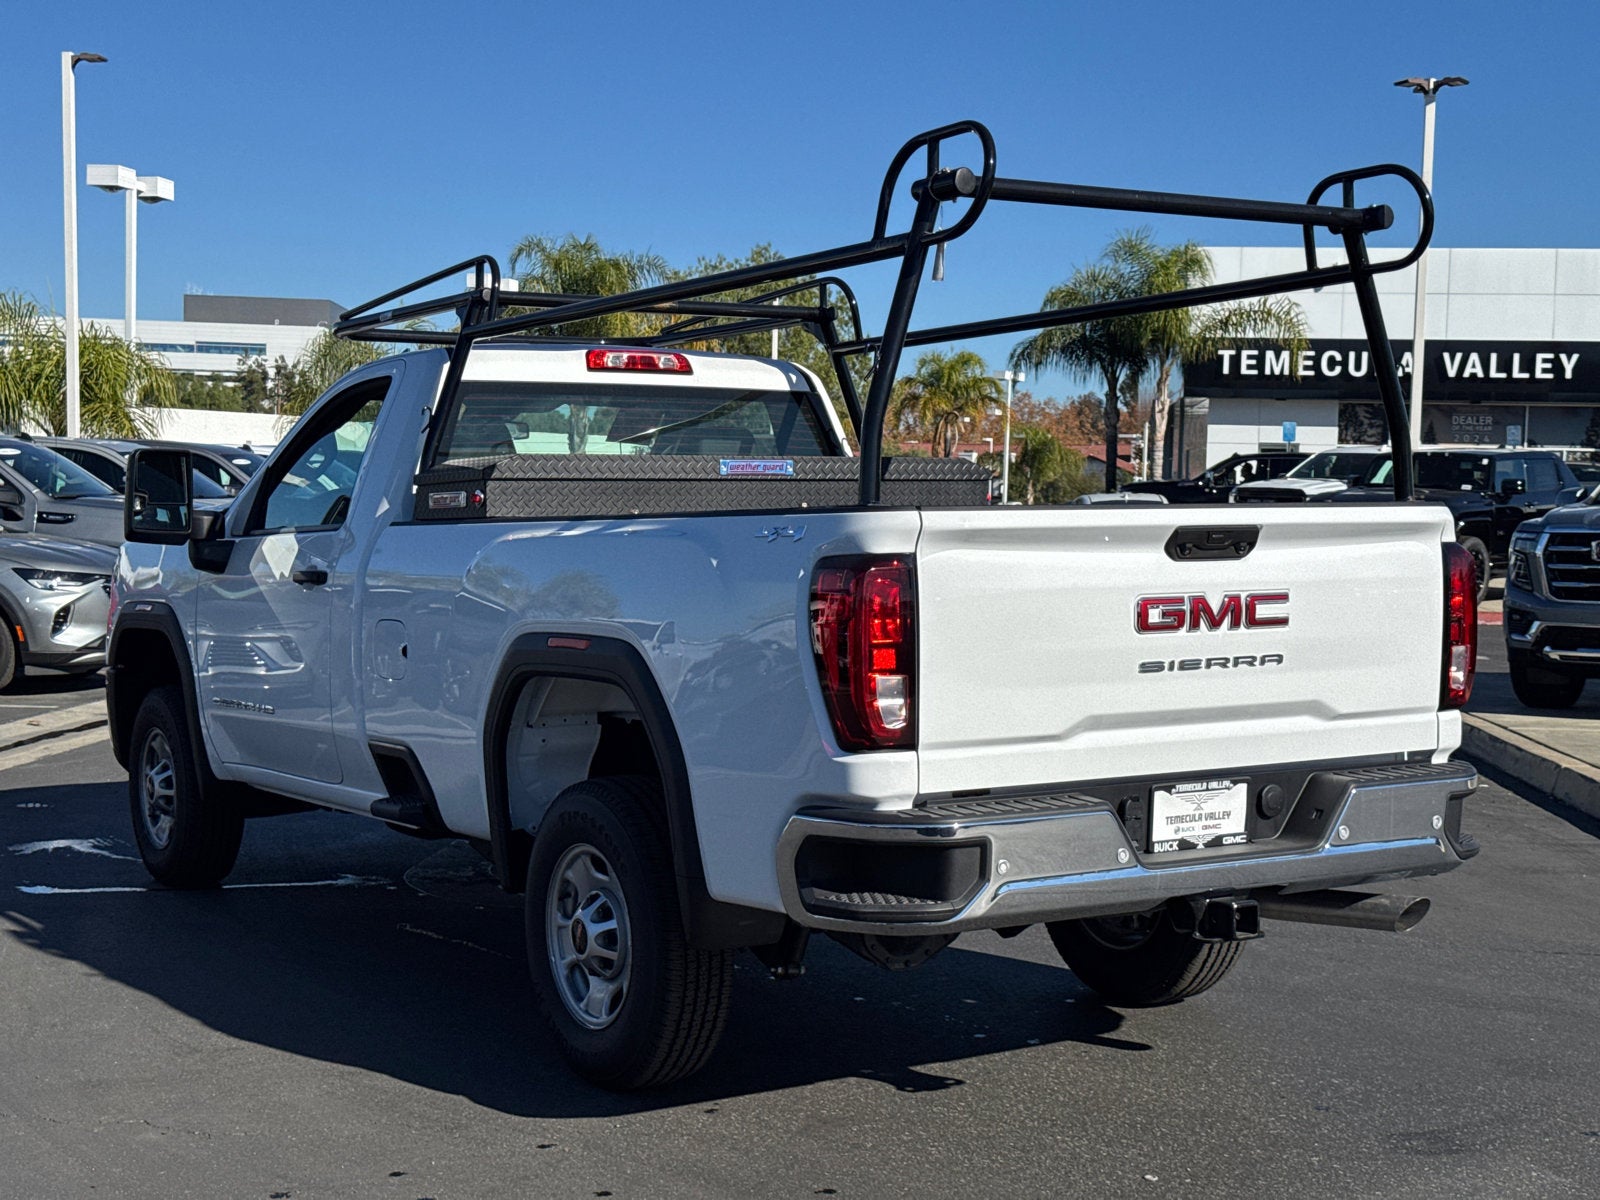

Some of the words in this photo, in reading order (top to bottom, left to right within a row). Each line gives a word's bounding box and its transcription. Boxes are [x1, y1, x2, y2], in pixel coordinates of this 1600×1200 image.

[1218, 349, 1413, 377] TEMECUA
[1442, 352, 1580, 379] VALLEY
[1452, 415, 1493, 425] DEALER
[1453, 434, 1490, 442] 2024
[729, 462, 760, 471] weather
[762, 462, 784, 472] guard
[1133, 589, 1290, 635] GMC
[1138, 653, 1284, 674] SIERRA
[1175, 782, 1207, 792] TEMECULA
[1208, 780, 1231, 790] VALLEY
[1165, 813, 1203, 826] TEMECULA
[1204, 810, 1231, 822] VALLEY
[1201, 823, 1222, 831] GMC
[1153, 840, 1179, 853] BUICK
[1222, 835, 1247, 845] GMC
